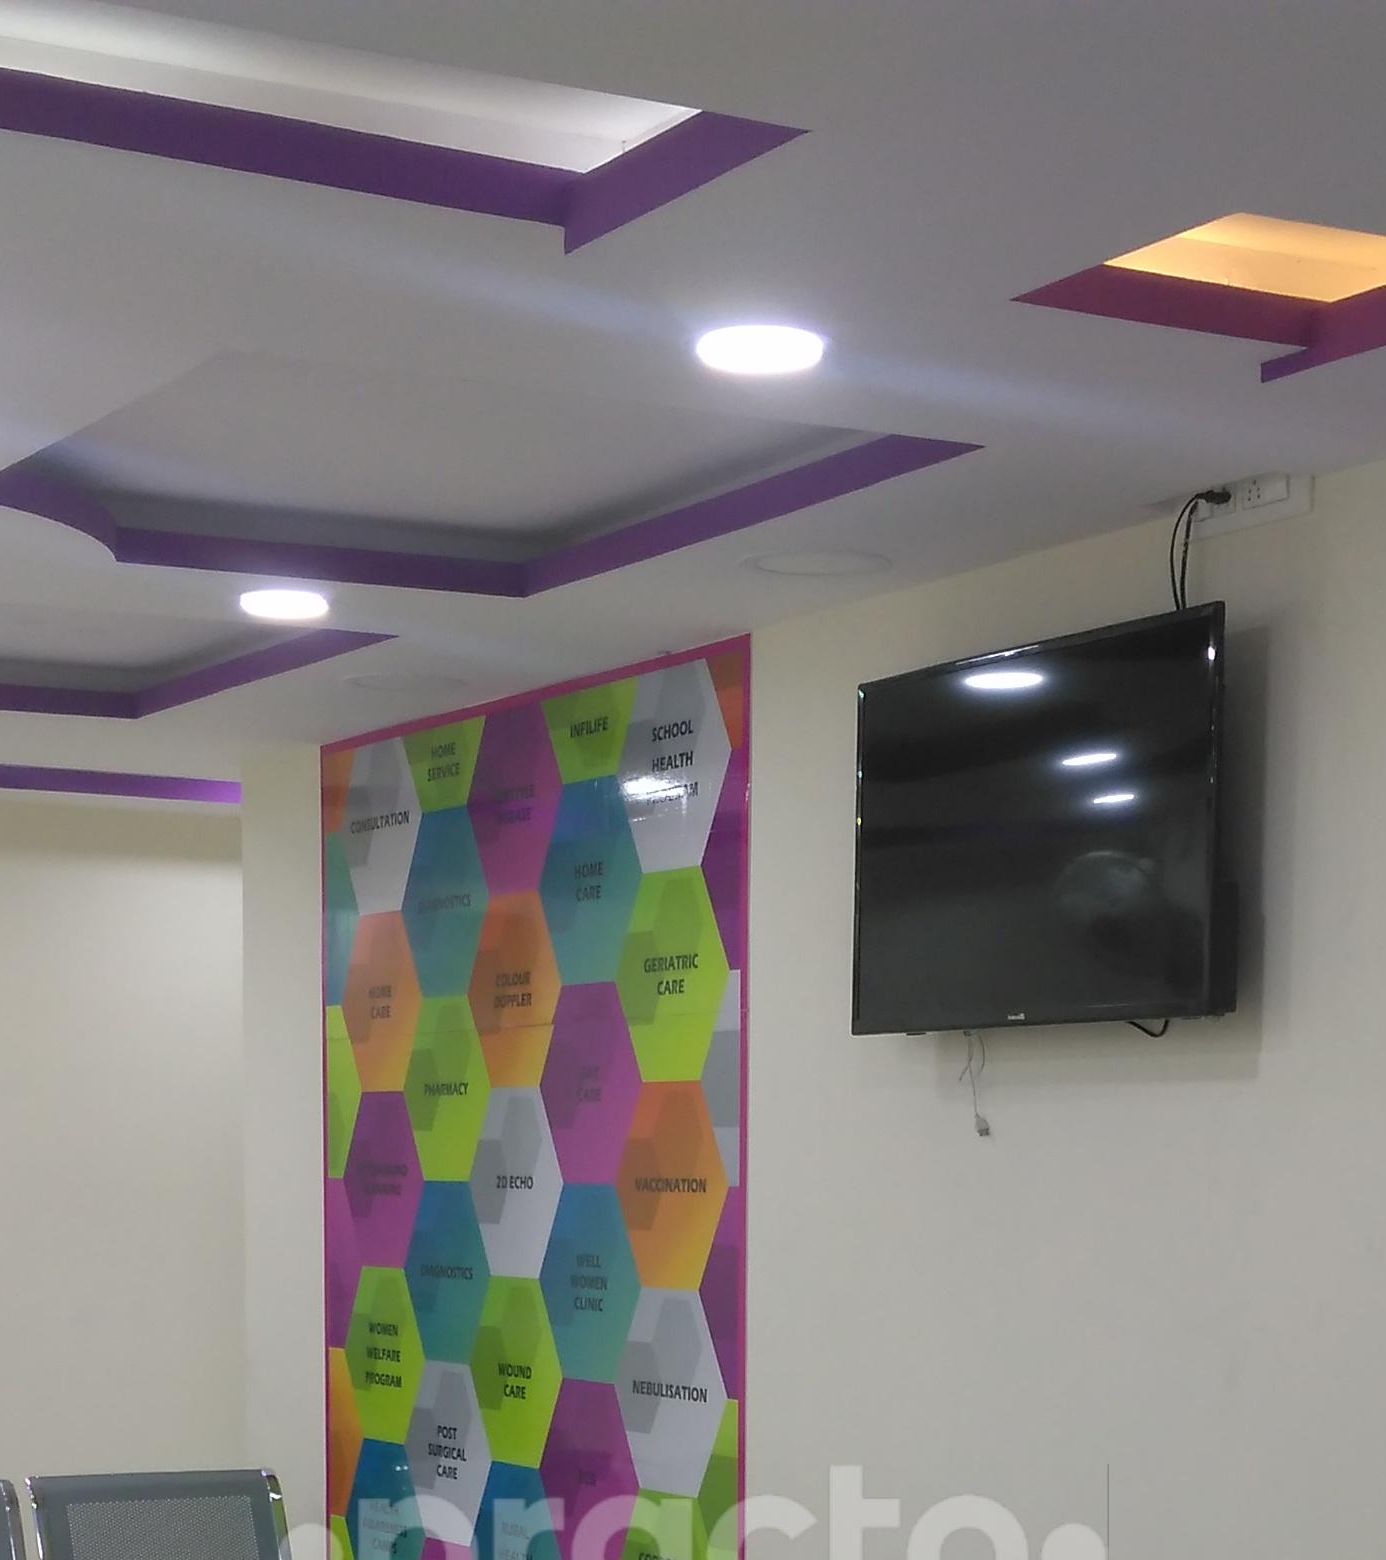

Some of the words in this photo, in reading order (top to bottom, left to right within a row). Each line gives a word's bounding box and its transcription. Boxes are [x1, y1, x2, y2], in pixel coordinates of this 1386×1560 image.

[570, 717, 608, 737] INFILIFE
[651, 720, 693, 743] SCHOOL
[431, 742, 456, 760] HOME
[651, 751, 693, 772] HEALTH
[427, 762, 459, 782] SERVICE
[350, 811, 410, 835] CONSULTATION
[574, 862, 603, 879] HOME
[576, 884, 601, 901] CARE
[643, 953, 699, 973] GERIATRIC
[495, 971, 531, 987] COLOUR
[657, 978, 684, 996] CARE
[494, 992, 532, 1008] DOPPLER
[423, 1082, 468, 1097] PHARMACY
[510, 1175, 533, 1190] ECHO
[635, 1178, 706, 1194] VACCINATION
[576, 1255, 601, 1269] WELL
[420, 1265, 473, 1281] DIAGNOSTICS
[570, 1275, 607, 1291] WOMEN
[573, 1297, 604, 1312] CLINIC
[368, 1322, 398, 1337] WOMEN
[366, 1348, 401, 1363] WELFARE
[498, 1363, 532, 1380] WOUND
[365, 1372, 402, 1388] PROGRAM
[504, 1383, 526, 1400] CARE
[632, 1380, 708, 1403] NEBULISATION
[437, 1425, 457, 1440] POST
[428, 1443, 467, 1462] SURGICAL
[436, 1464, 458, 1480] CARE
